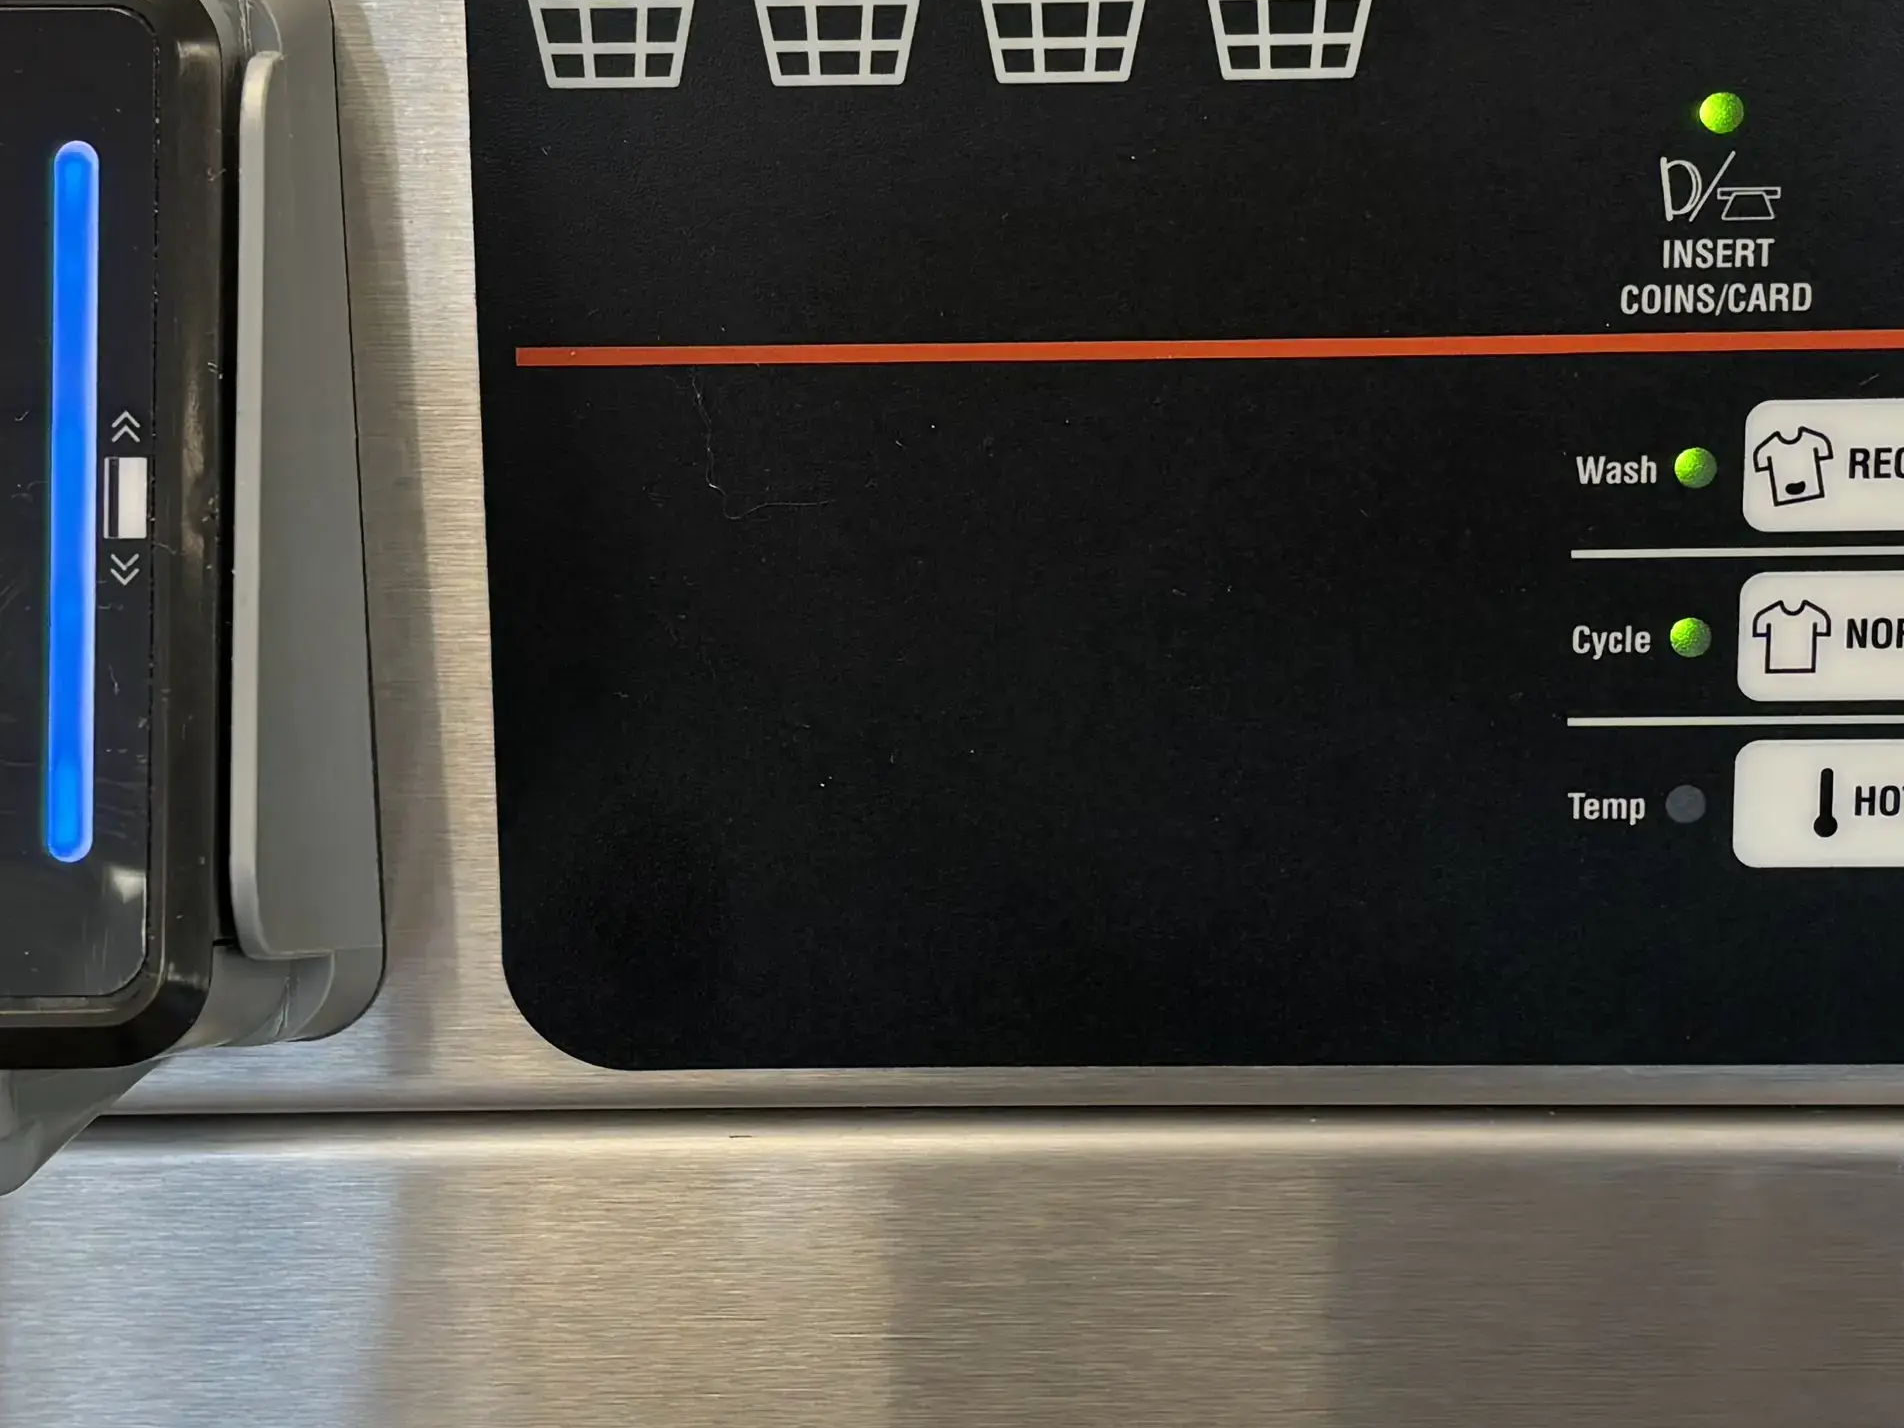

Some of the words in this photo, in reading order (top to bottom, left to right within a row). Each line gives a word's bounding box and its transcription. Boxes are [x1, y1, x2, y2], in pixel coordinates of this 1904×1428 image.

[1663, 238, 1775, 269] INSERT
[1620, 282, 1812, 316] COINS/CARD
[1575, 454, 1657, 485] Wash
[1572, 625, 1651, 661] Cycle
[1567, 792, 1646, 826] Temp
